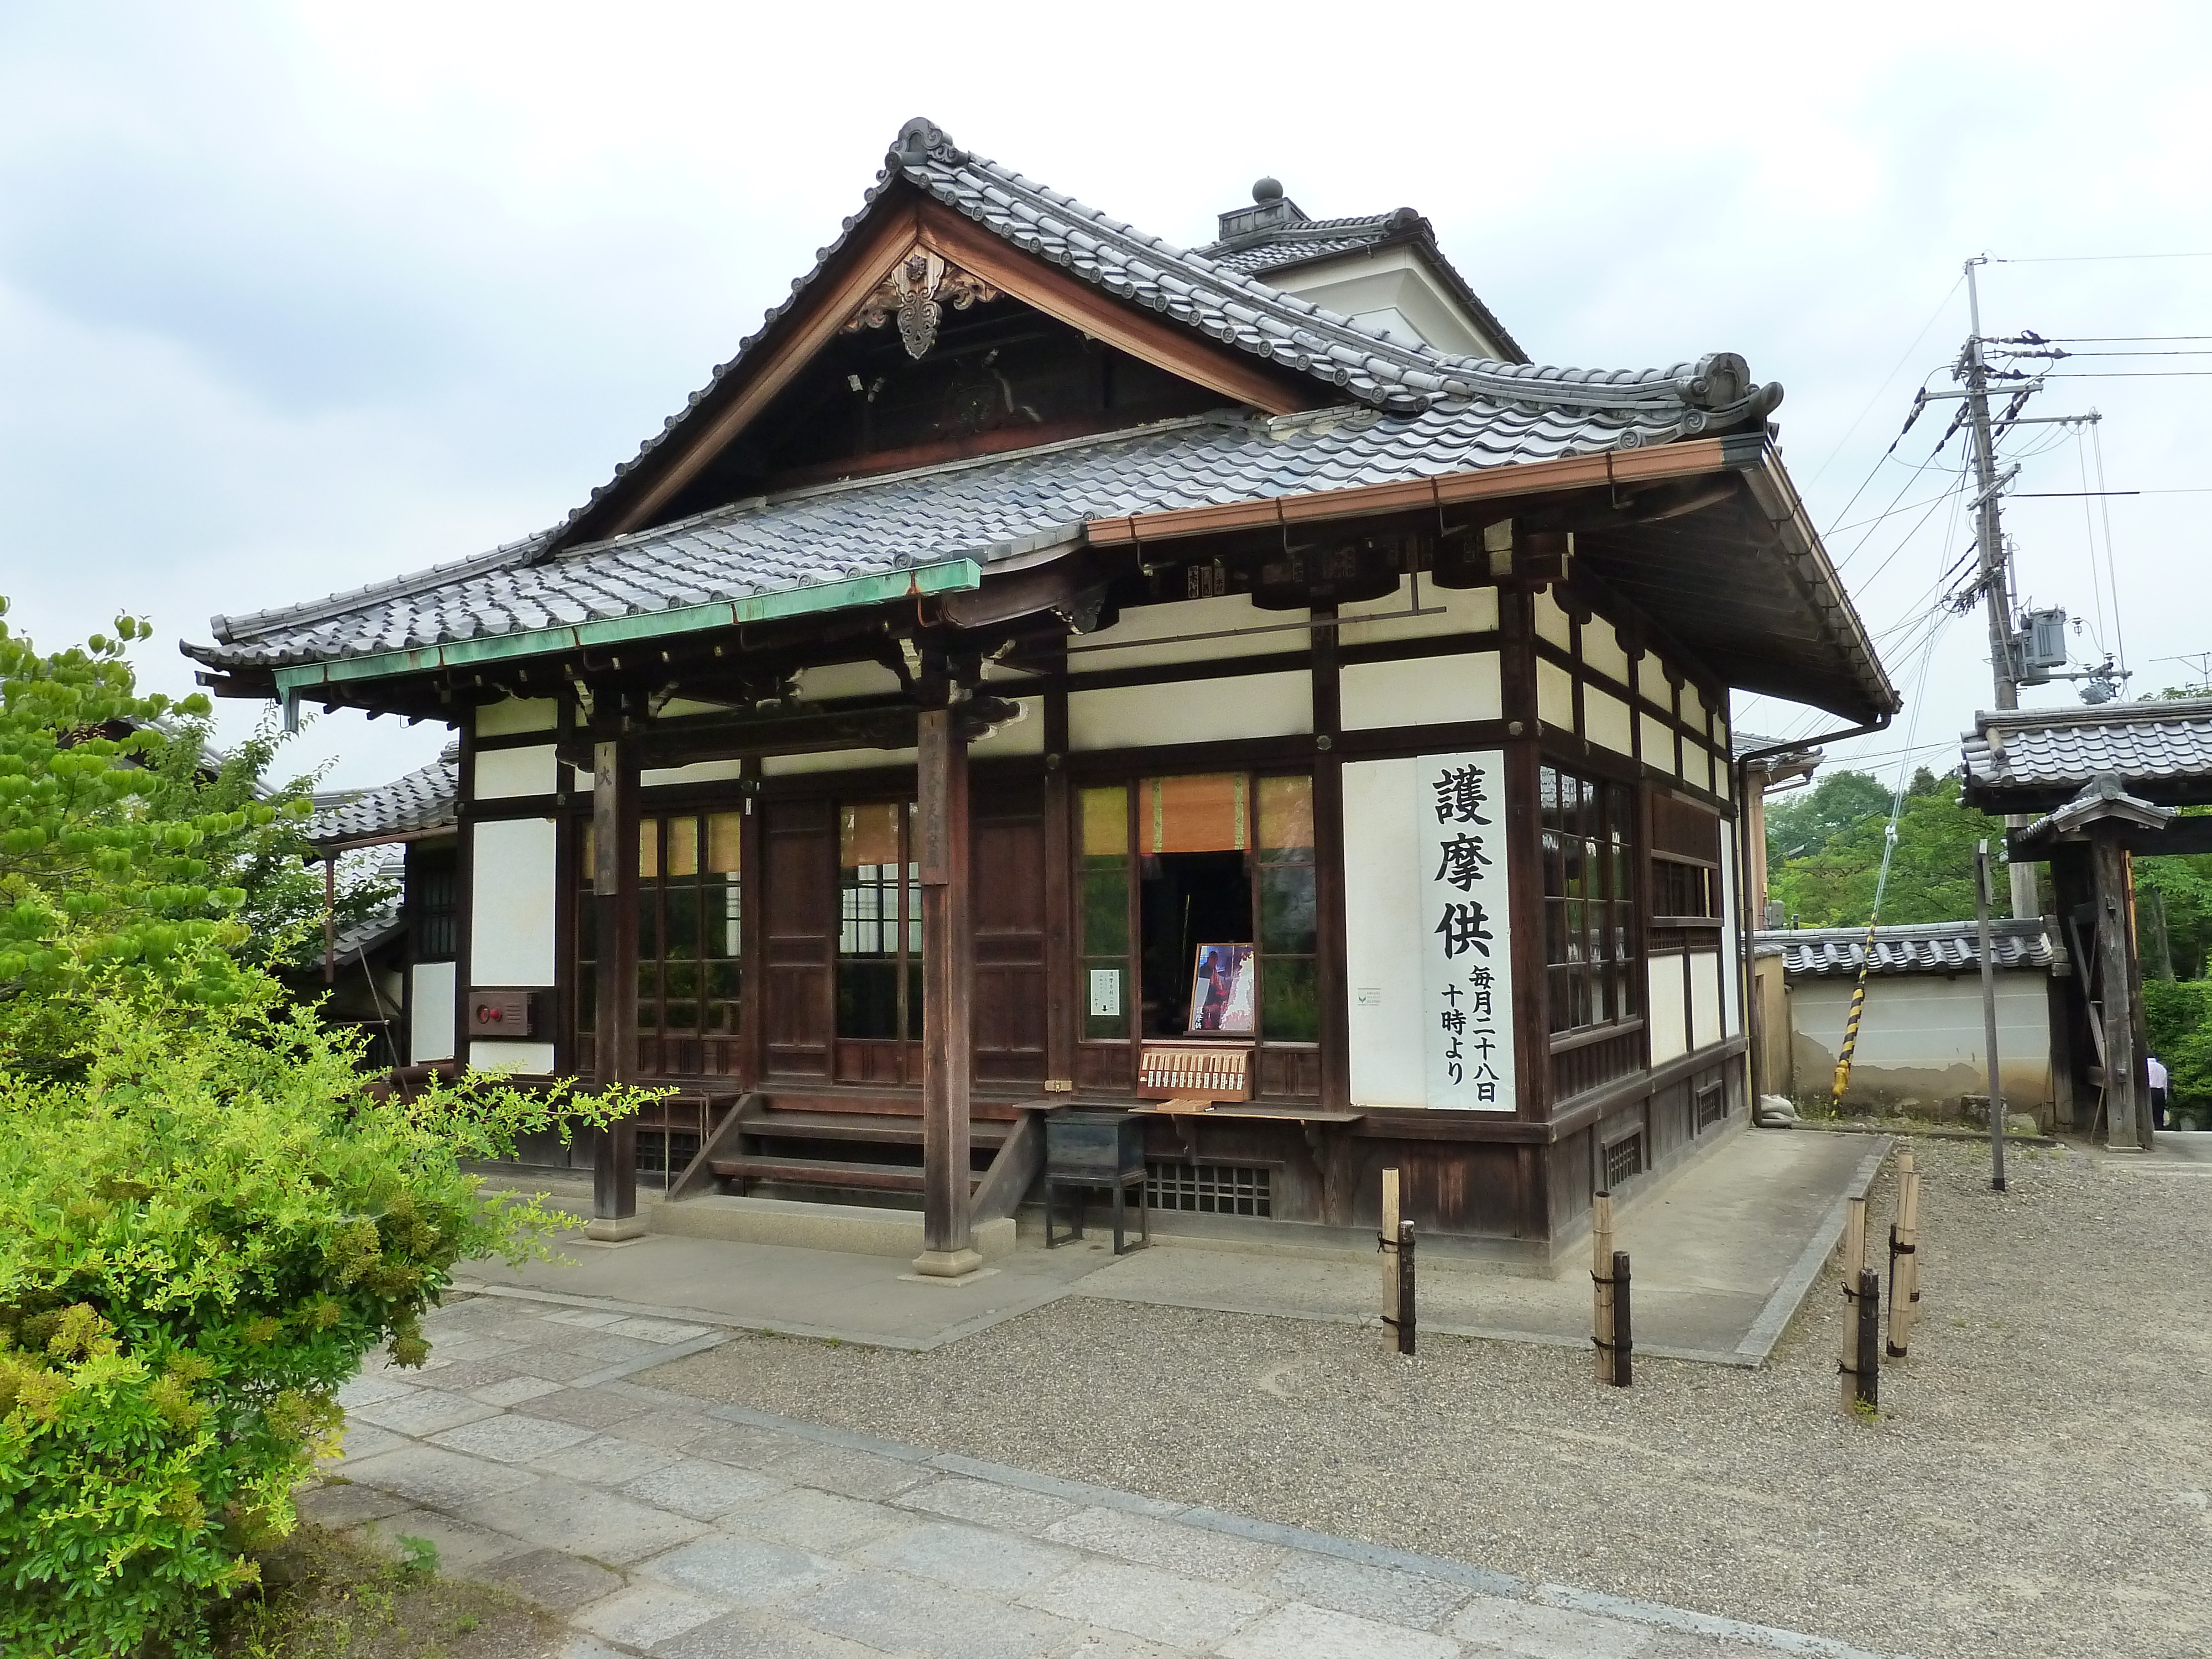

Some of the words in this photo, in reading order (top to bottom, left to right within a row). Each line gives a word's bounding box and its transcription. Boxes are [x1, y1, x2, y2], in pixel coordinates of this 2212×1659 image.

[1433, 764, 1493, 959] 護摩供
[1441, 984, 1466, 1084] 十時より
[1469, 966, 1499, 1102] 毎月二十八日
